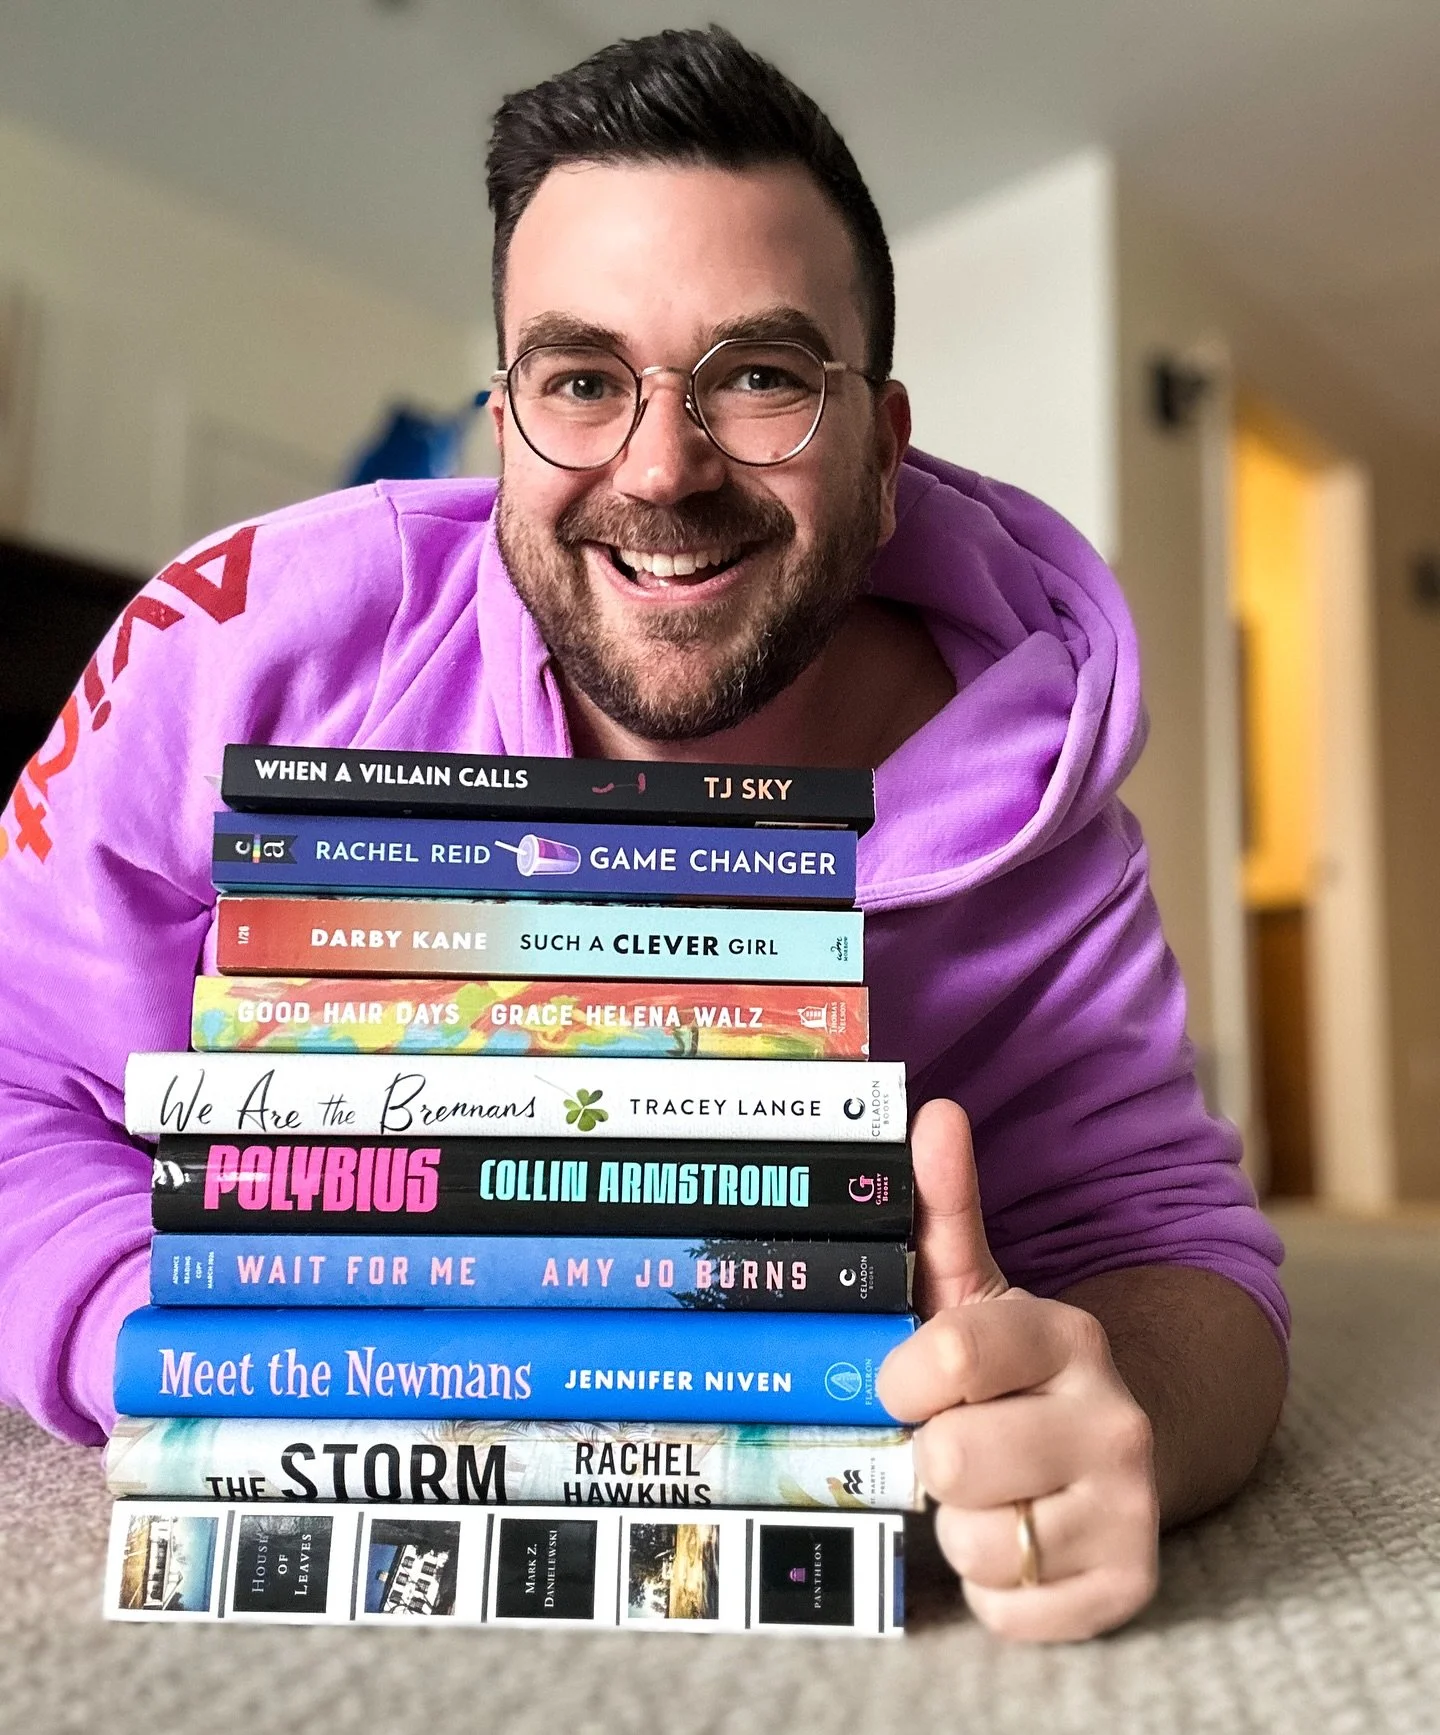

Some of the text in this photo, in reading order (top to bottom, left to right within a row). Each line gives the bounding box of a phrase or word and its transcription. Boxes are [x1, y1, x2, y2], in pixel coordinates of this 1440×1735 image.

[255, 759, 529, 789] WHEN A VILLAIN CALLS
[704, 777, 792, 800] TJ SKY
[316, 841, 490, 864] RACHEL REID
[590, 847, 836, 875] GAME CHANGER
[311, 928, 487, 950] DARBY KANE
[520, 934, 778, 956] SUCH A CLEVER GIRL
[238, 1001, 460, 1025] GOOD HAIR DAYS
[491, 1003, 763, 1028] GRACE HELENA WALZ
[829, 1002, 838, 1034] THOMAS
[838, 1002, 846, 1034] NELSON
[161, 1069, 537, 1135] We Are the Brennans
[630, 1098, 821, 1117] TRACEY LANGE
[872, 1080, 880, 1137] CELADON
[204, 1144, 441, 1213] POLYBIUS
[480, 1159, 810, 1208] COLLIN ARMSTRONG
[172, 1256, 180, 1284] ADVANCE
[237, 1255, 477, 1285] WAIT FOR ME
[542, 1257, 808, 1290] AMY JO BURNS
[860, 1255, 868, 1299] CELADON
[159, 1346, 532, 1401] Meet the Newmans
[564, 1368, 792, 1393] JENNIFER NIVEN
[206, 1443, 508, 1505] THE STORM
[575, 1442, 701, 1476] RACHEL
[563, 1482, 712, 1506] HAWKINS
[251, 1534, 269, 1594] HOUSE
[278, 1553, 288, 1576] OF
[295, 1533, 312, 1596] LEAVES
[524, 1543, 538, 1595] MARK Z.
[544, 1529, 558, 1608] DANIELEWSKI
[813, 1543, 822, 1609] PANTHEON
